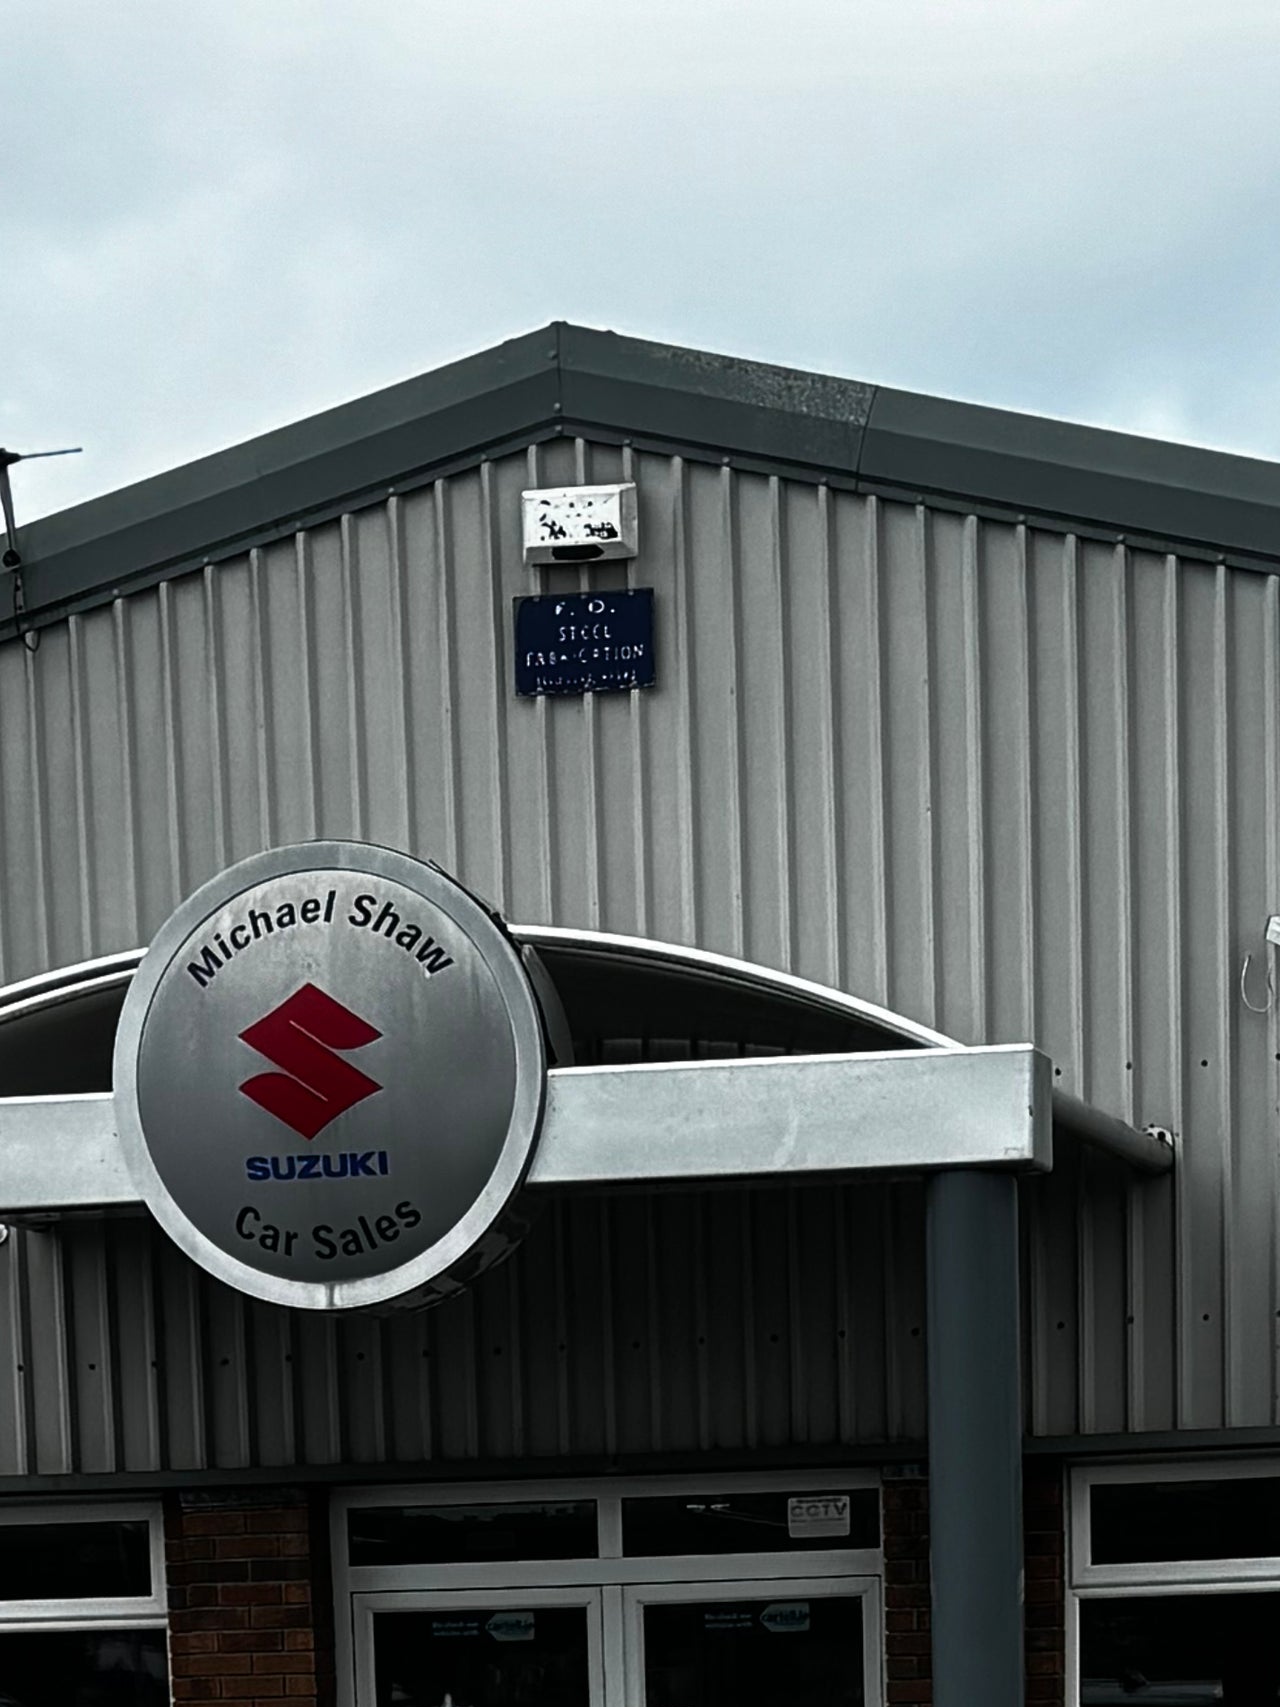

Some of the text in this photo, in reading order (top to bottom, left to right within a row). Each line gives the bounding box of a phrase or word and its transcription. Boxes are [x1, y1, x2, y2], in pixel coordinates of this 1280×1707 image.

[185, 889, 455, 988] Michael Shaw
[245, 1150, 389, 1181] SUZUKI
[235, 1200, 422, 1260] Car Sales
[790, 1502, 848, 1519] CCTV
